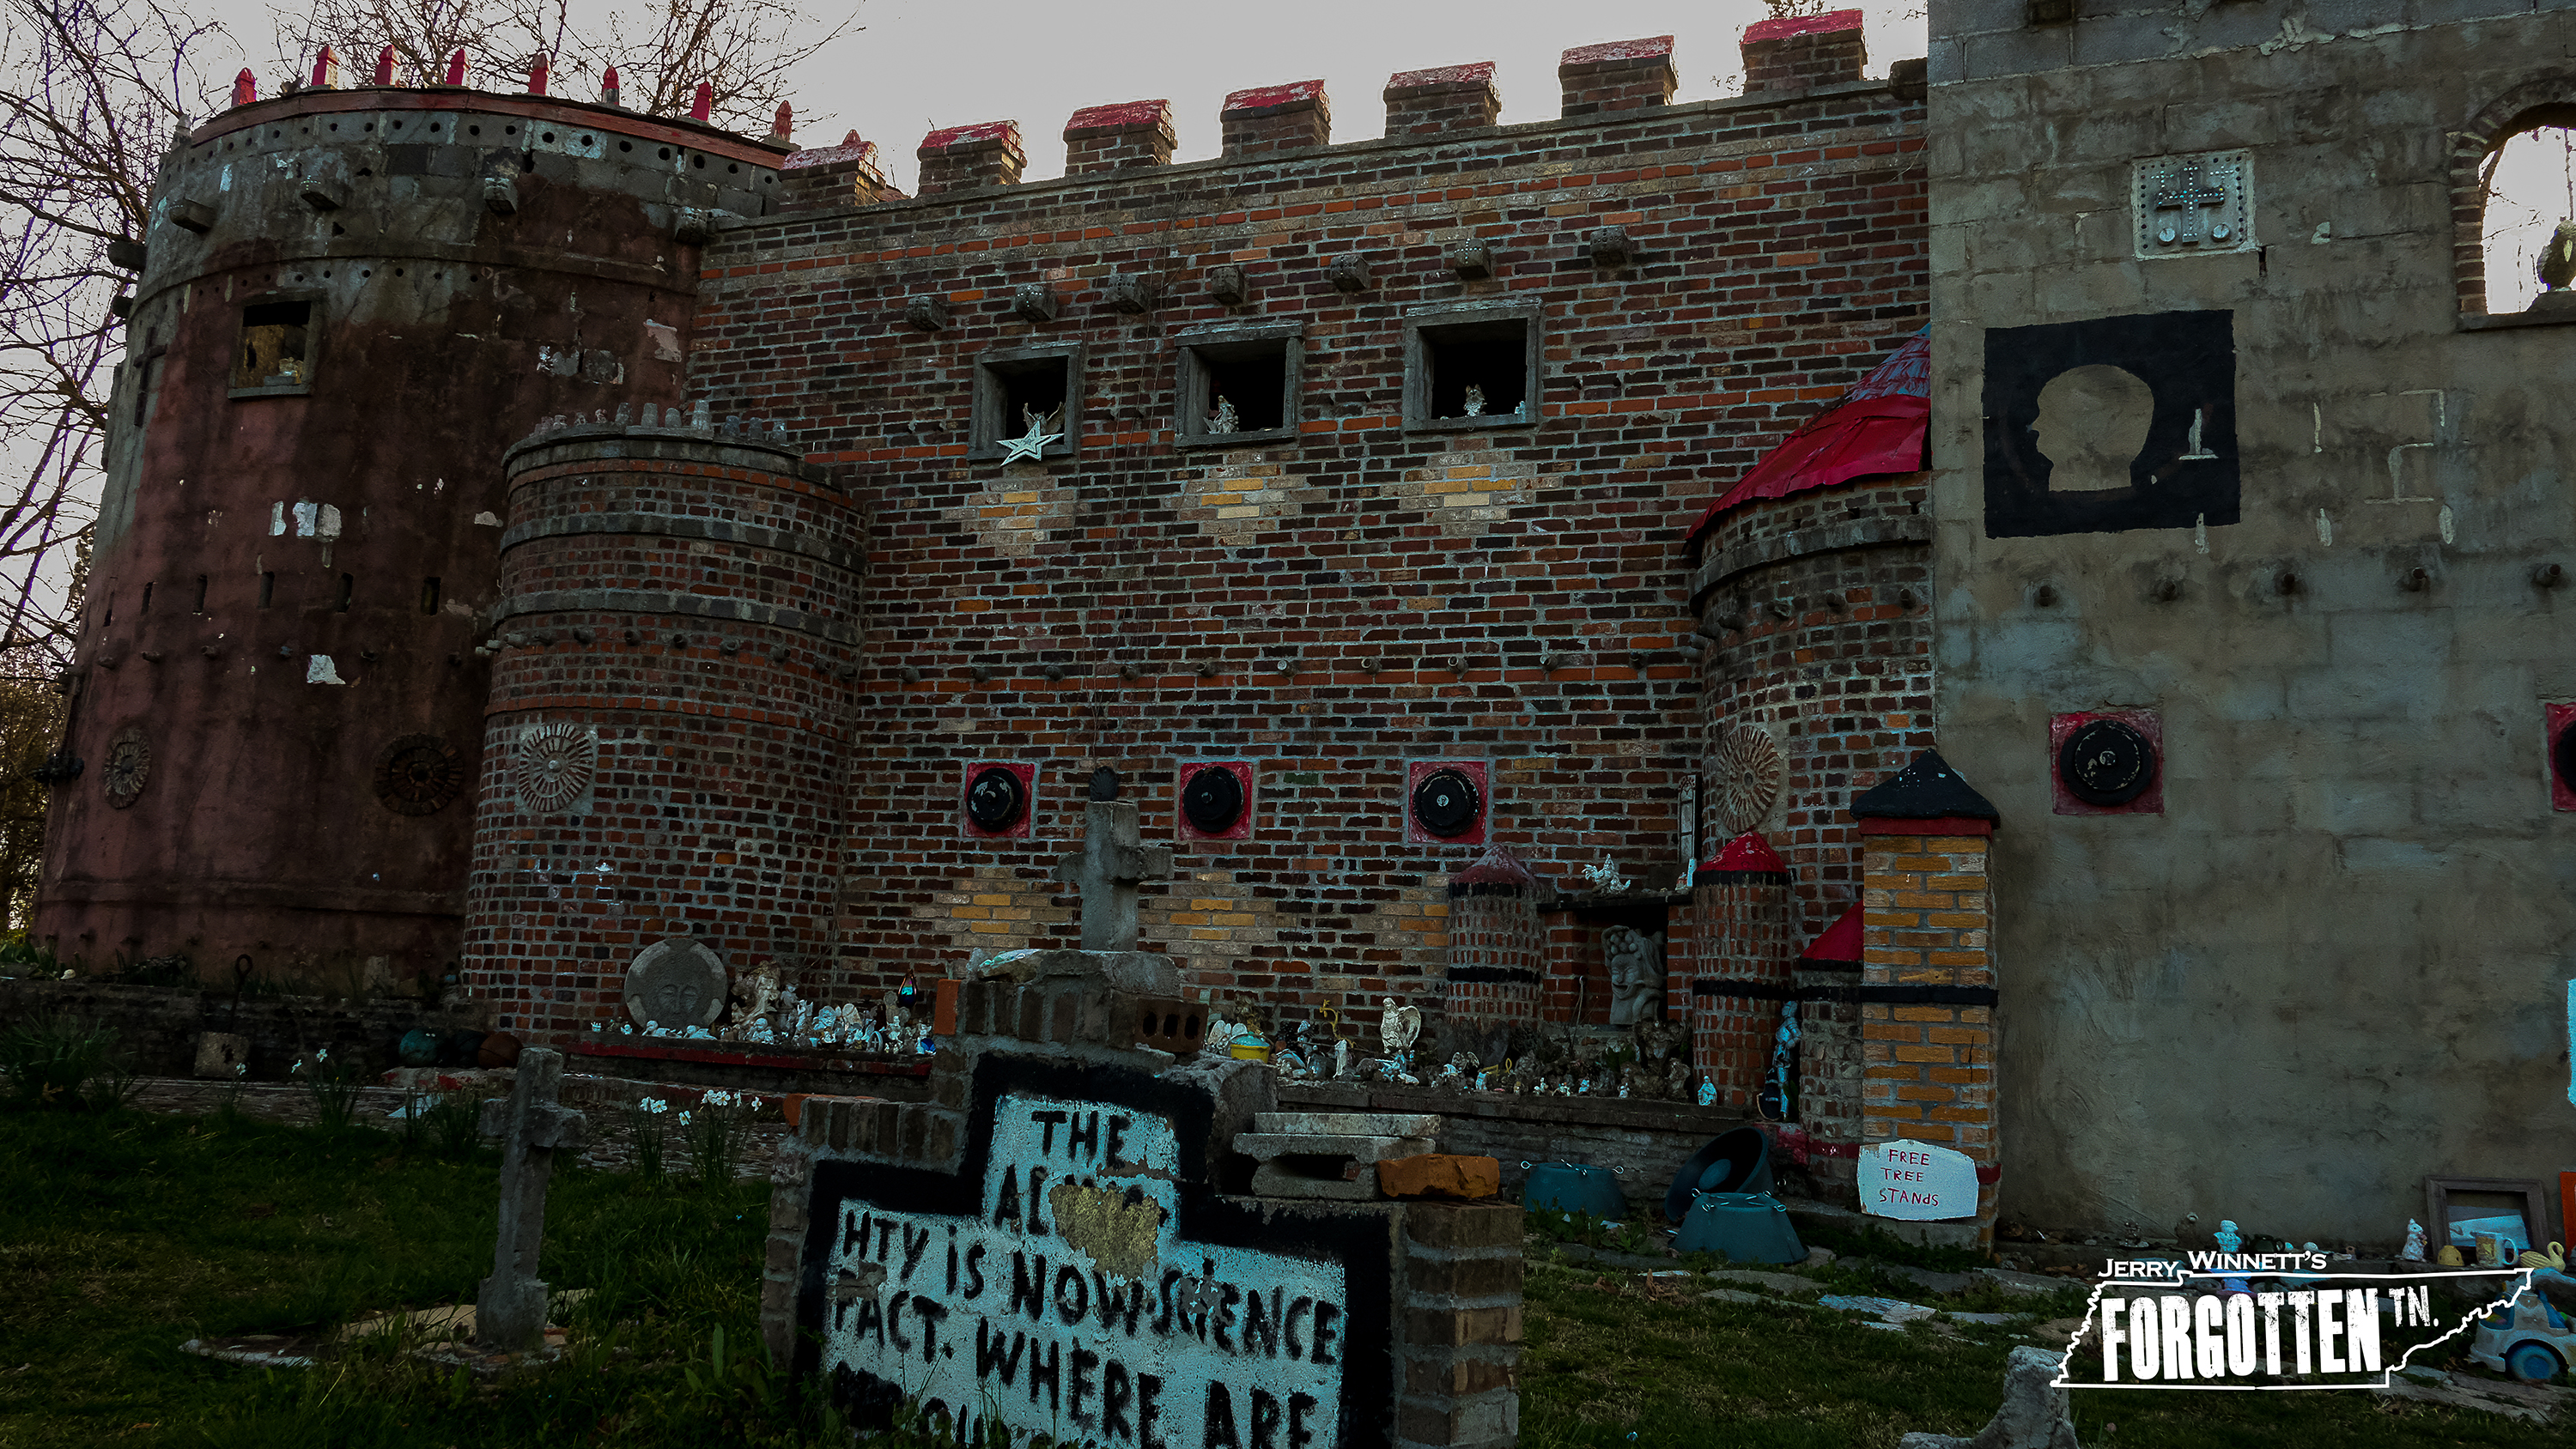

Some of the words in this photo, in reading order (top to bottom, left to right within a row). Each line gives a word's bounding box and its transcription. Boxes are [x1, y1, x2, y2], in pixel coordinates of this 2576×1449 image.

[1031, 1110, 1130, 1171] THE
[1888, 1149, 1930, 1166] FREE
[1880, 1167, 1924, 1182] TREE
[842, 1210, 930, 1284] HTY
[975, 1316, 1166, 1449] WHERE
[1202, 1379, 1319, 1449] ARE
